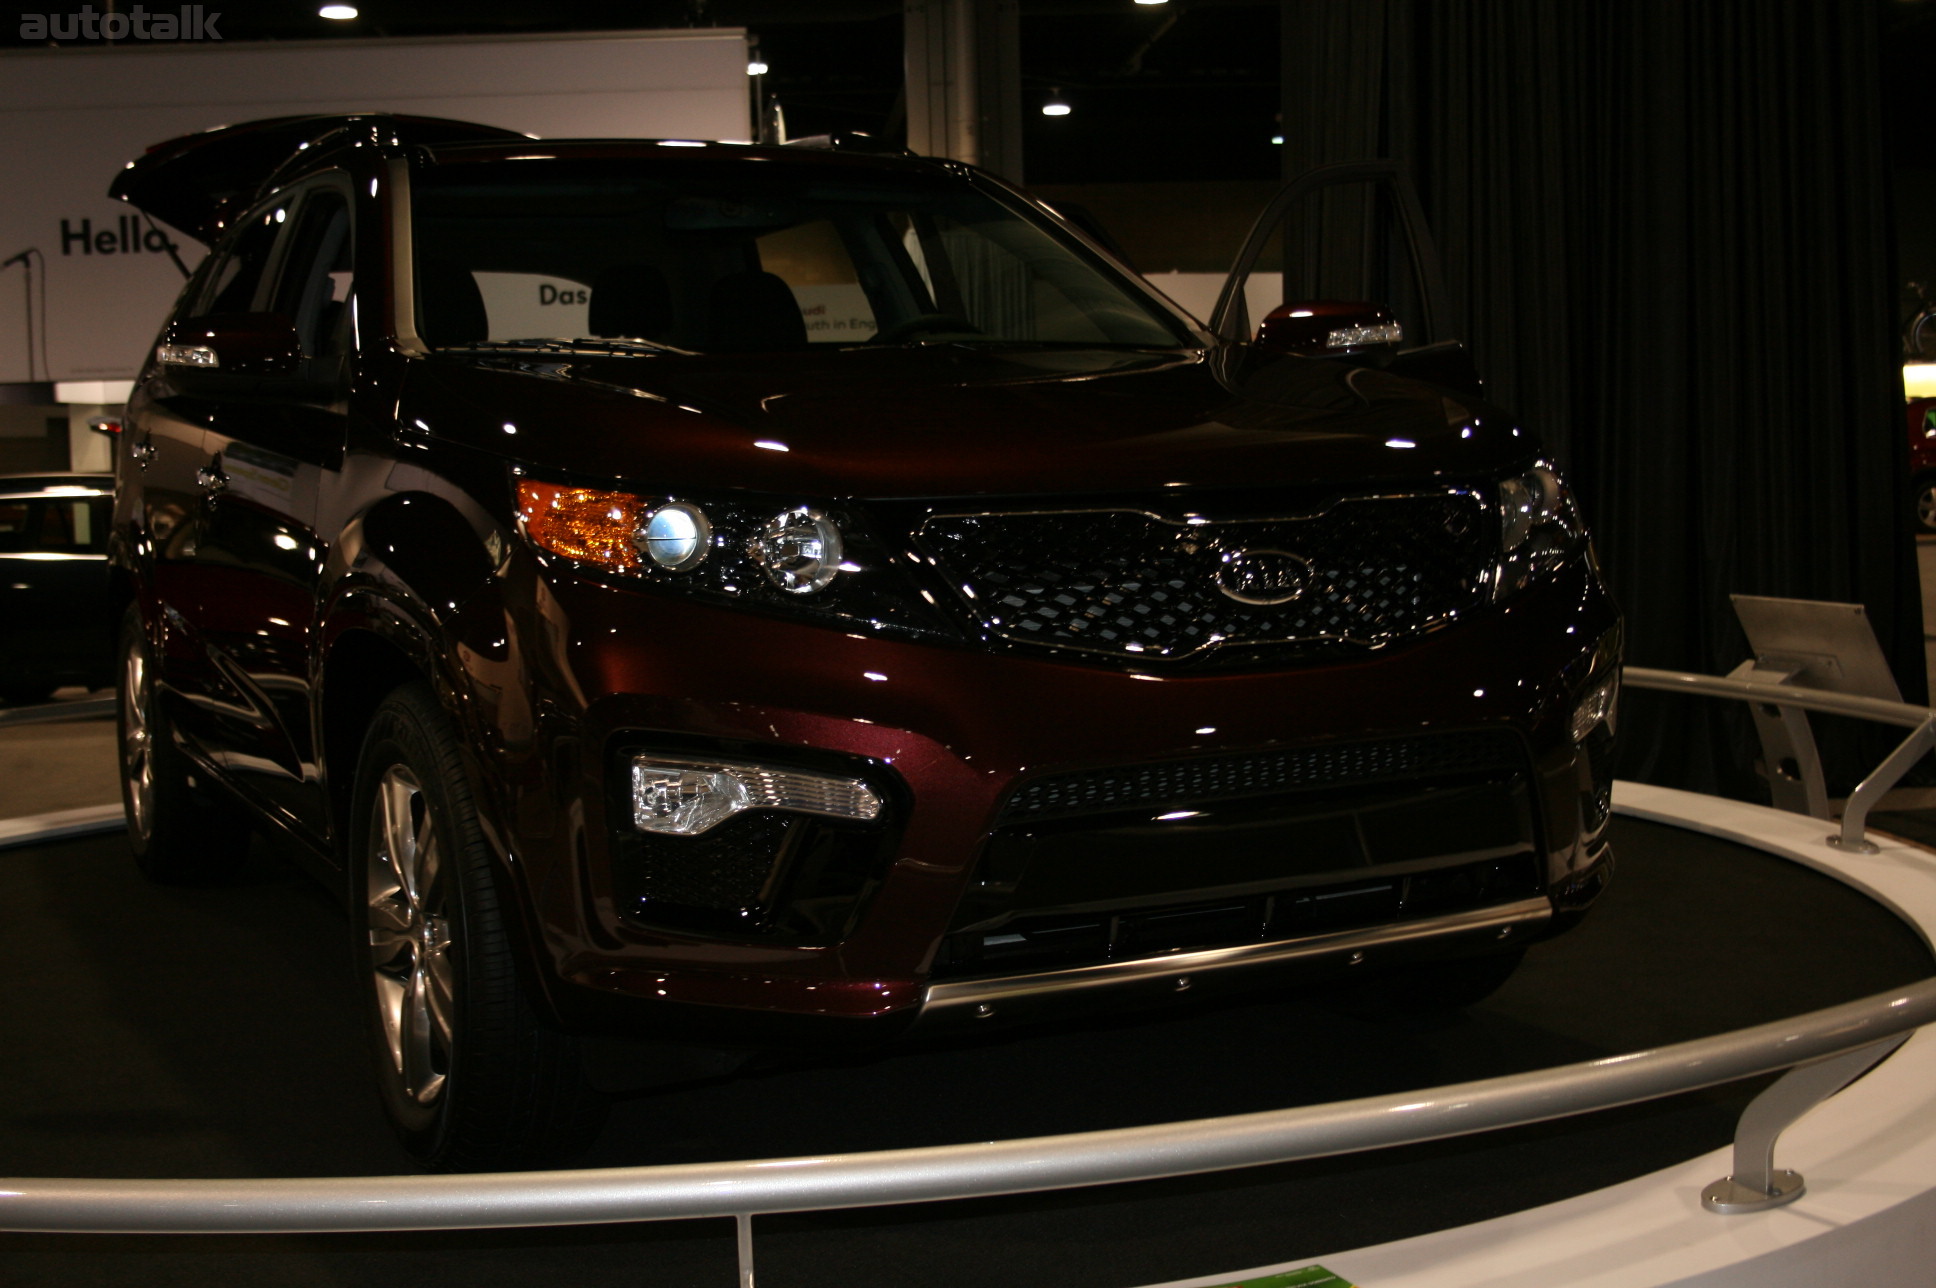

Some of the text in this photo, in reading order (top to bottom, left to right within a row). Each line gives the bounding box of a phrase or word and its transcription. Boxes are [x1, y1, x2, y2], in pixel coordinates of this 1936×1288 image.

[539, 283, 588, 306] Das
[802, 304, 826, 316] udi
[806, 319, 830, 331] uth
[849, 317, 876, 332] Eng
